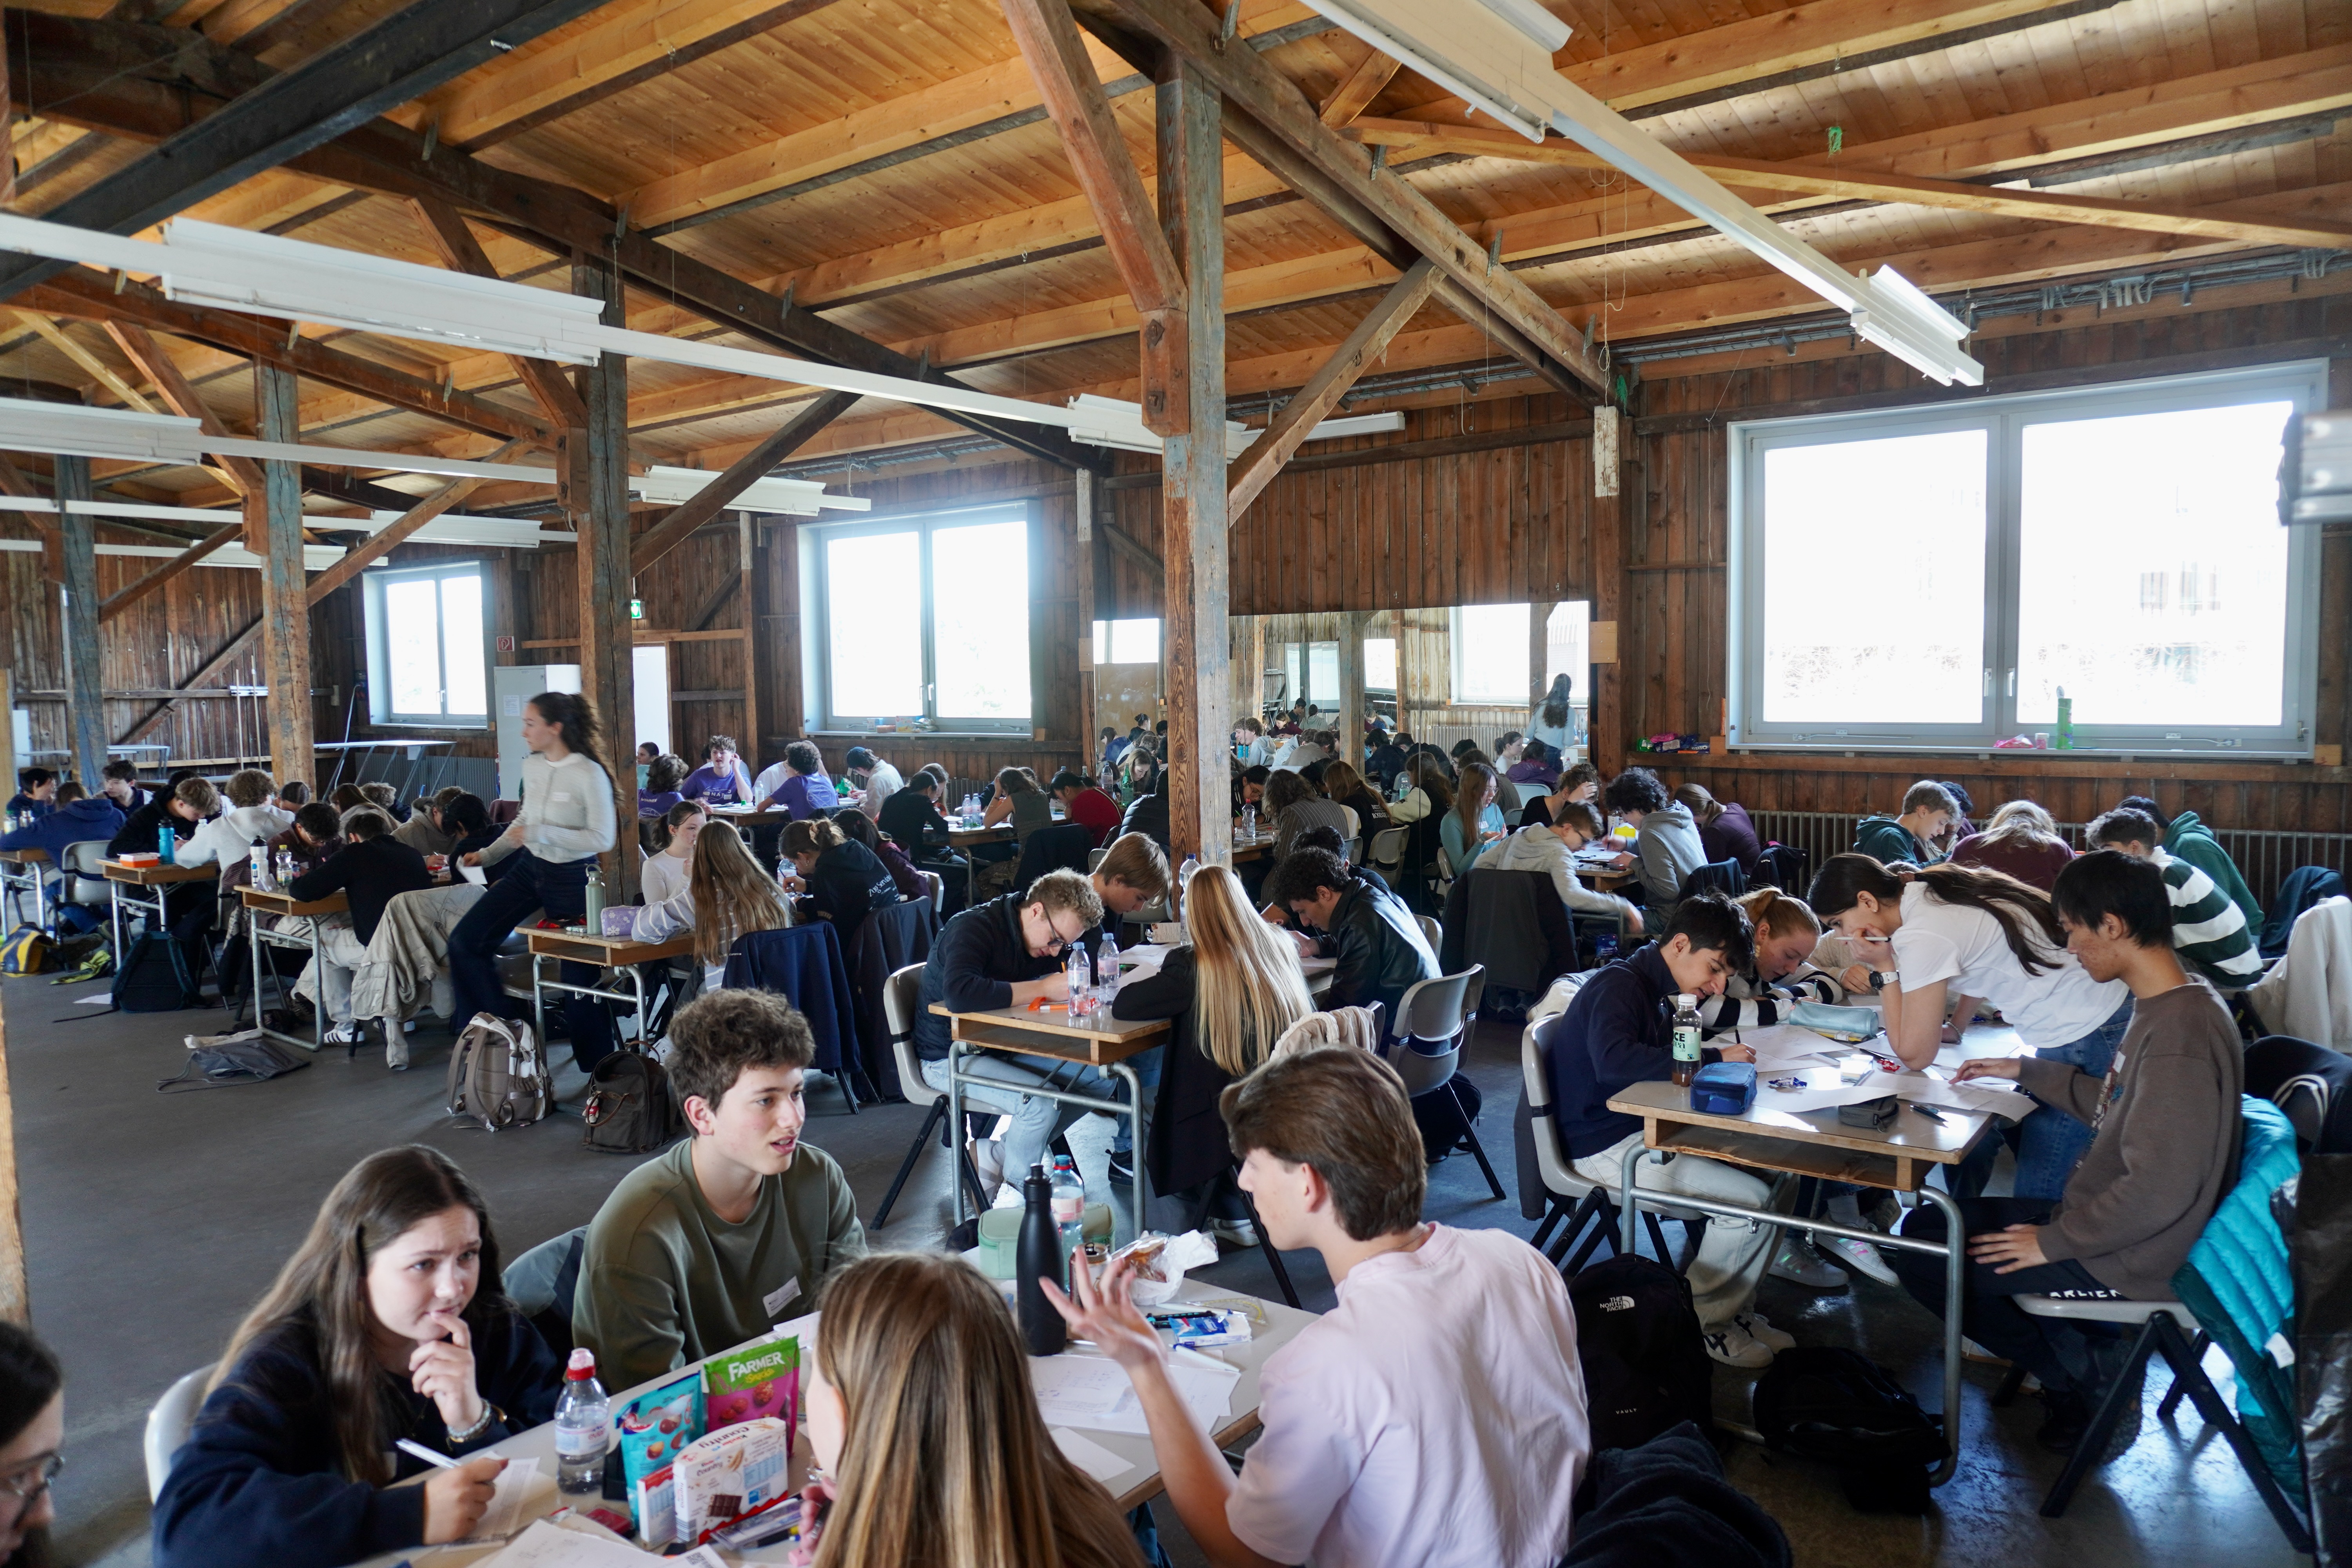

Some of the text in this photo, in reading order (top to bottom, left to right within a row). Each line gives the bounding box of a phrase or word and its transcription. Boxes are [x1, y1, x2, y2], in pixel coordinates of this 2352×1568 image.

[867, 885, 881, 897] Zug
[728, 1352, 785, 1382] FARMER
[698, 1426, 750, 1448] Country
